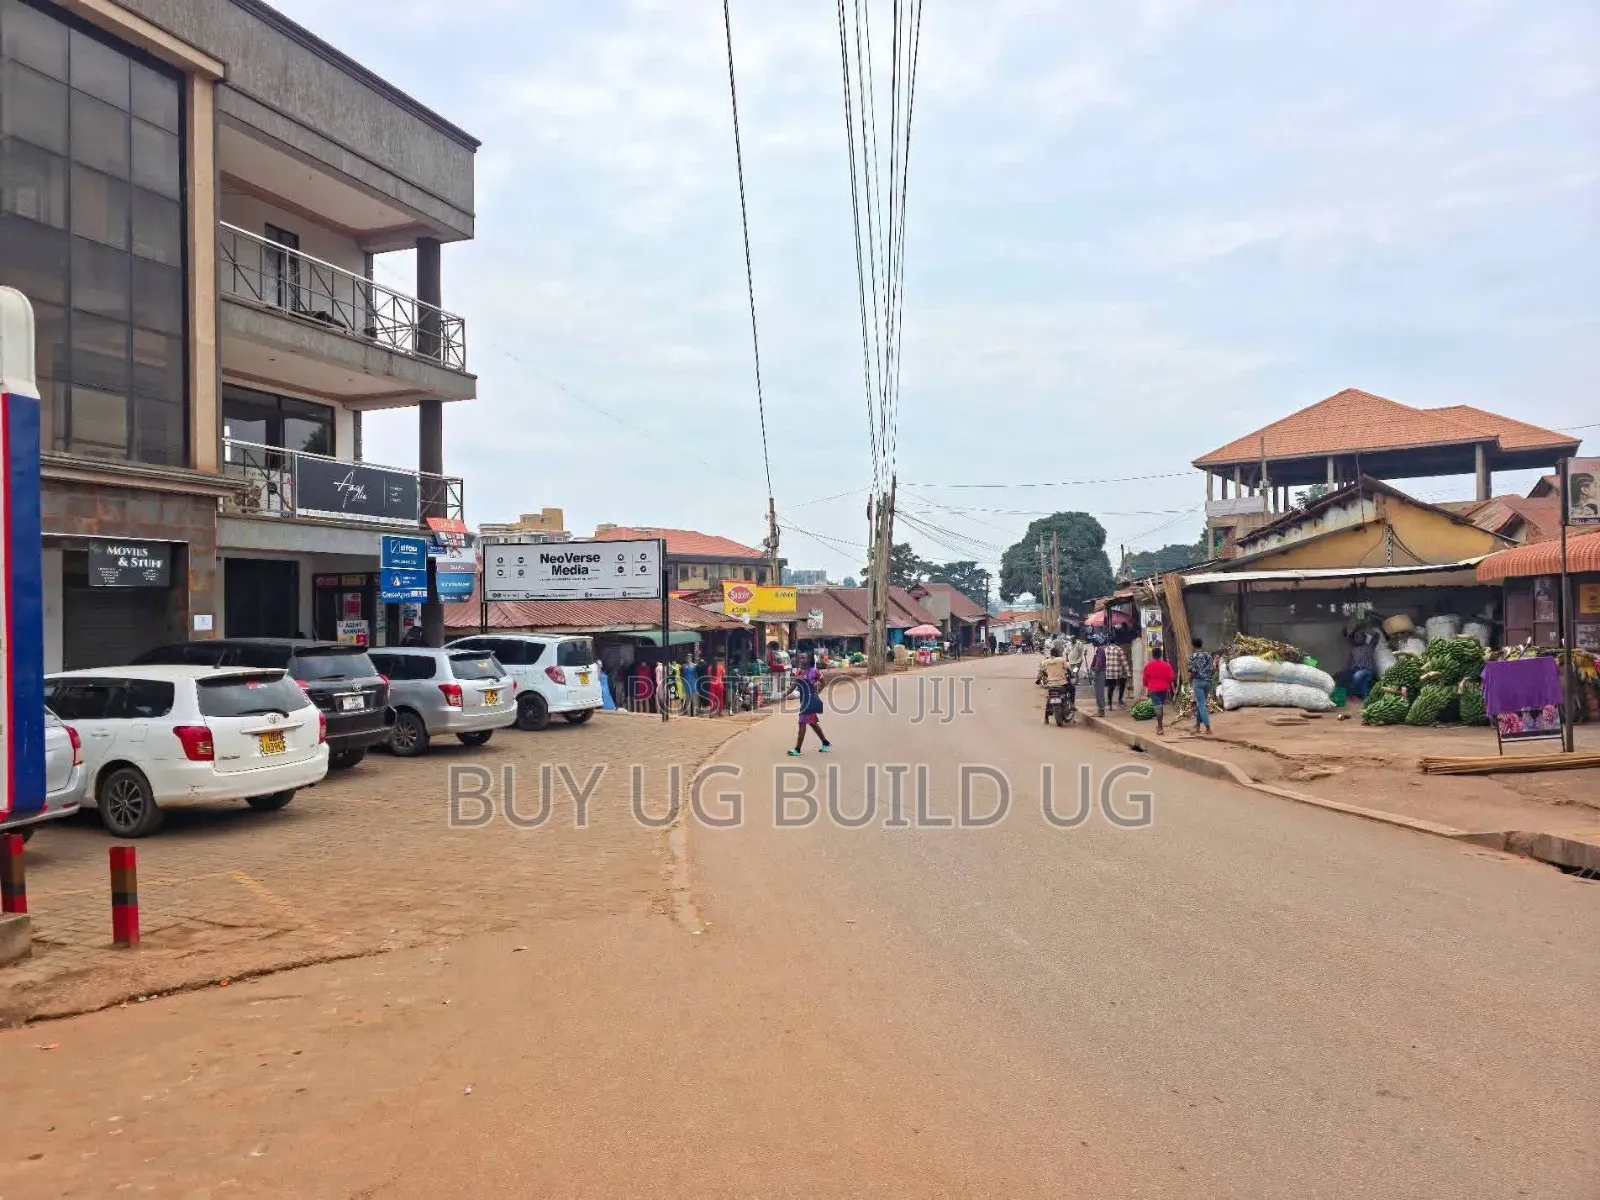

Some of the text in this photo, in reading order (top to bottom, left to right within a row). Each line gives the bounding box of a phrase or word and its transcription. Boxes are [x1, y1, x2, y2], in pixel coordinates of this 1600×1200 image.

[106, 545, 148, 557] MOVIES
[118, 557, 163, 568] & STUFF
[539, 552, 601, 564] NeoVerse
[551, 564, 589, 576] Media
